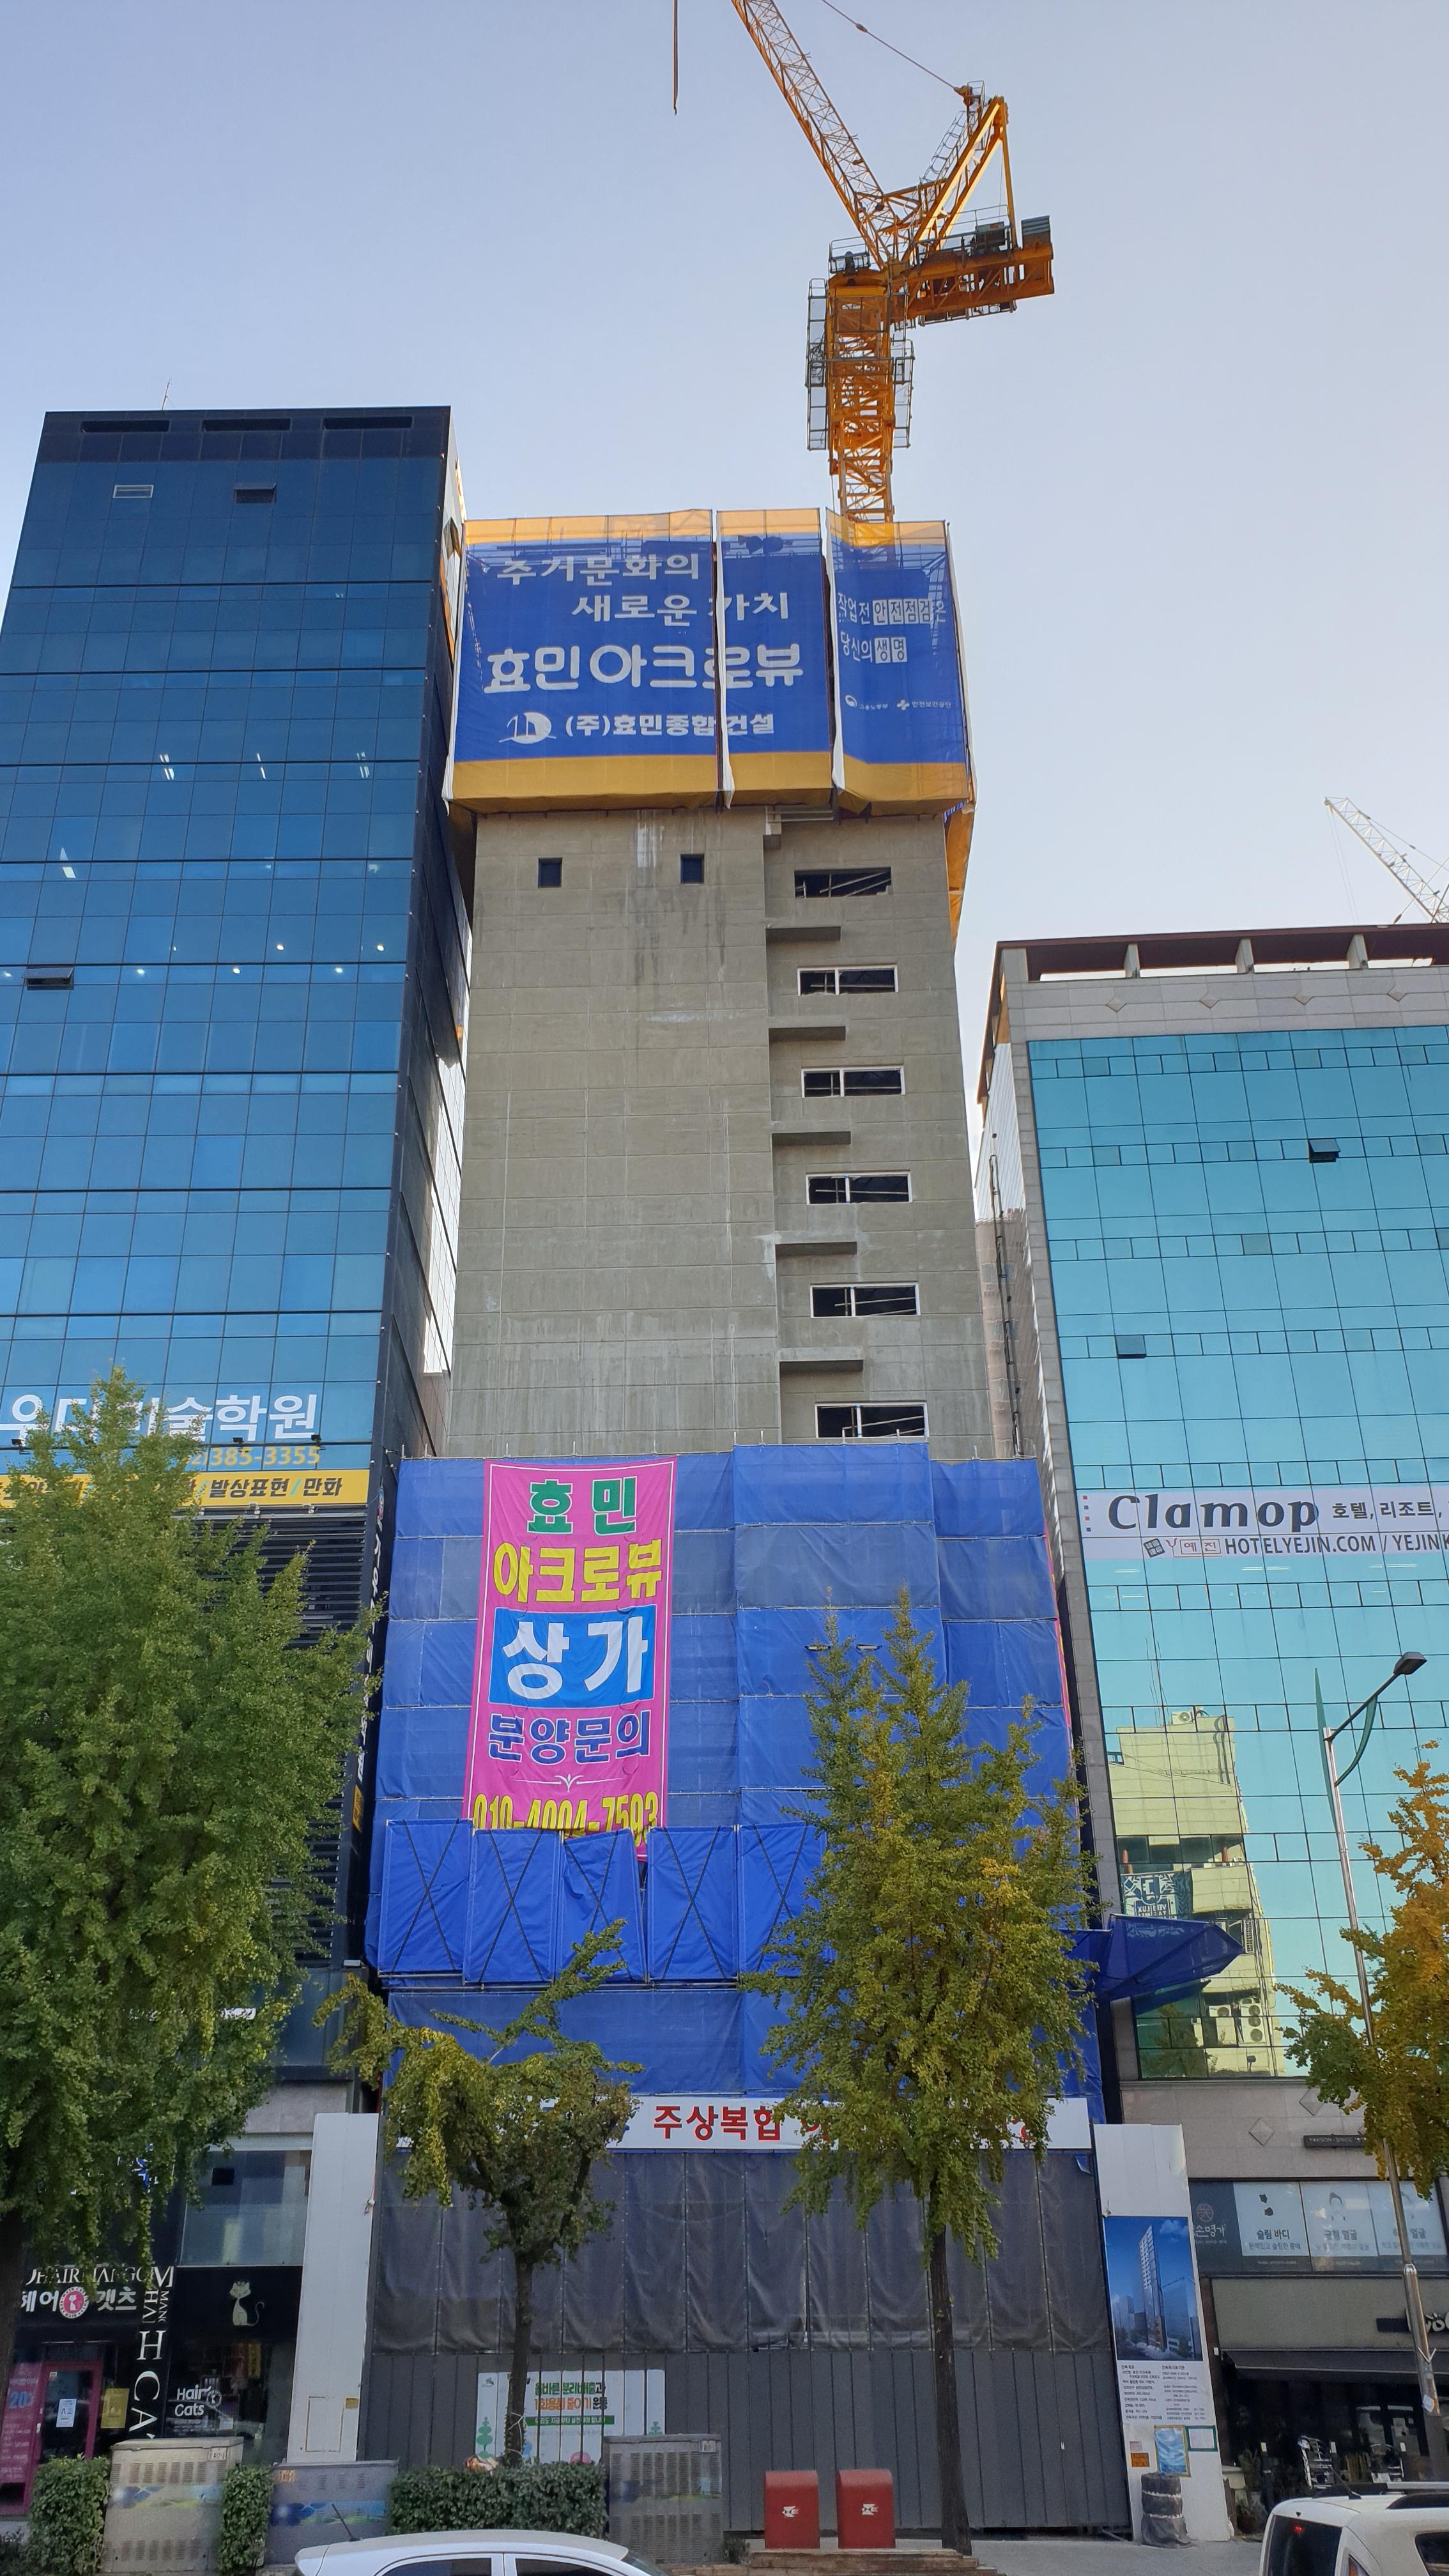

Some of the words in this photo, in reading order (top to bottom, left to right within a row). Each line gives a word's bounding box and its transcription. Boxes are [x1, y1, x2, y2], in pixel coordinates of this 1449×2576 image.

[497, 553, 699, 586] 주거문화의
[571, 595, 698, 627] 새로운
[708, 592, 788, 621] 가치
[840, 630, 873, 663] 당신의
[875, 637, 907, 664] 생명
[484, 643, 804, 694] 효민아크로뷰
[527, 1476, 638, 1536] 효민
[1108, 1493, 1319, 1533] Clamop
[1225, 1535, 1376, 1554] HOTELYEJIN.COM
[493, 1538, 663, 1603] 아크로뷰
[502, 1616, 648, 1700] 상가
[487, 1710, 652, 1765] 분양문의
[654, 2106, 781, 2140] 주상복합
[1193, 2223, 1225, 2237] 손명가
[1274, 2229, 1290, 2240] 바디
[176, 2384, 212, 2400] Hair
[174, 2403, 204, 2417] Cats
